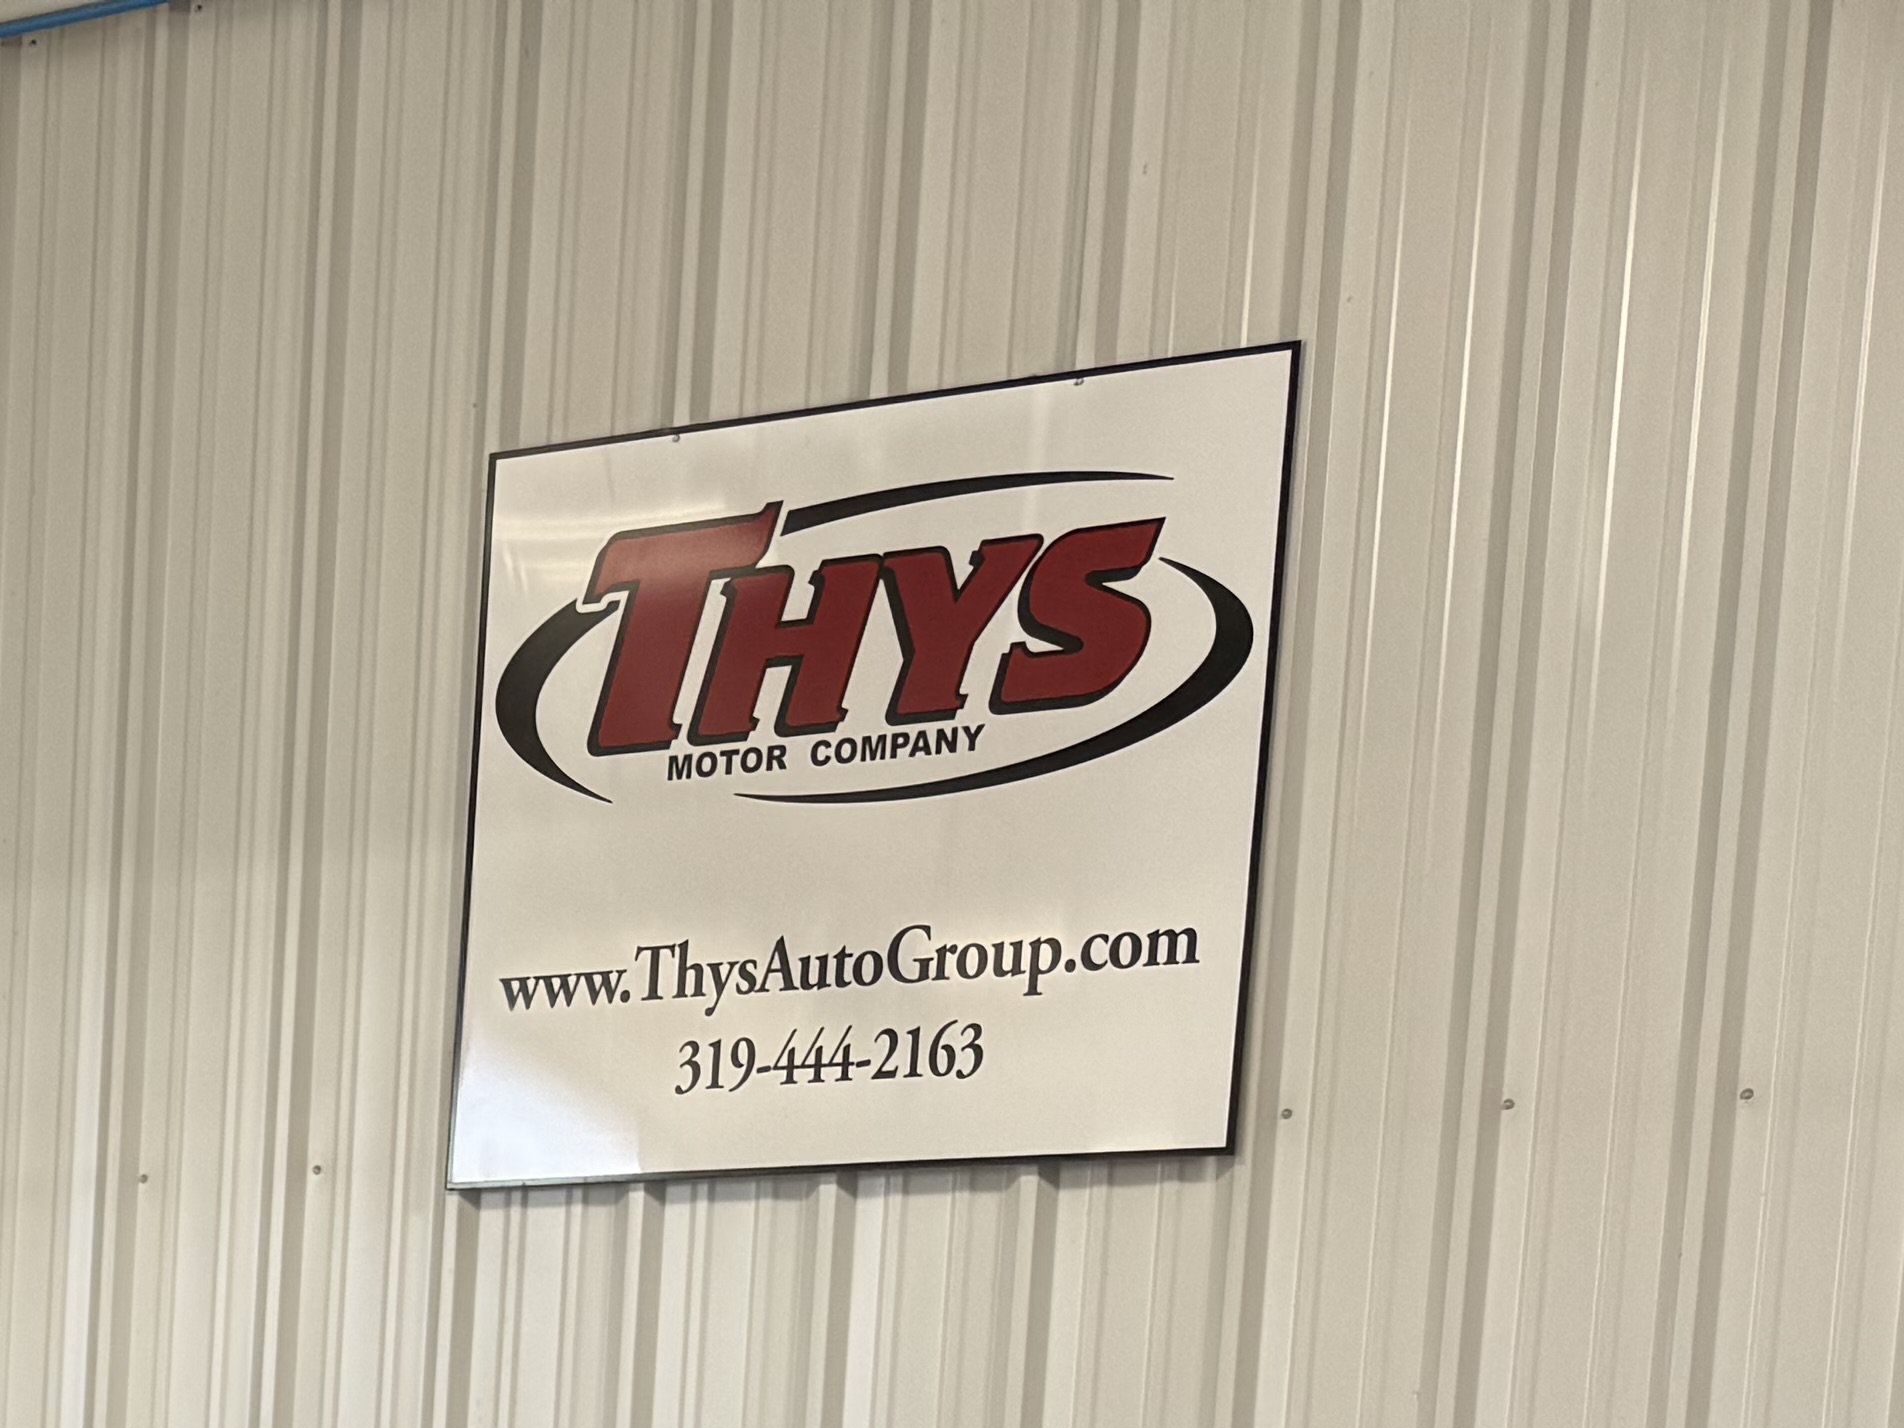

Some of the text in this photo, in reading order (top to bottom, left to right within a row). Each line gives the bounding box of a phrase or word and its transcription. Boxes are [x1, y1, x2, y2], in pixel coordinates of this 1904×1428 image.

[583, 500, 1166, 757] THYS
[666, 723, 986, 782] MOTOR COMPANY
[499, 923, 1201, 1018] www.ThysAutoGroup.com
[673, 1019, 985, 1096] 319-444-2163
